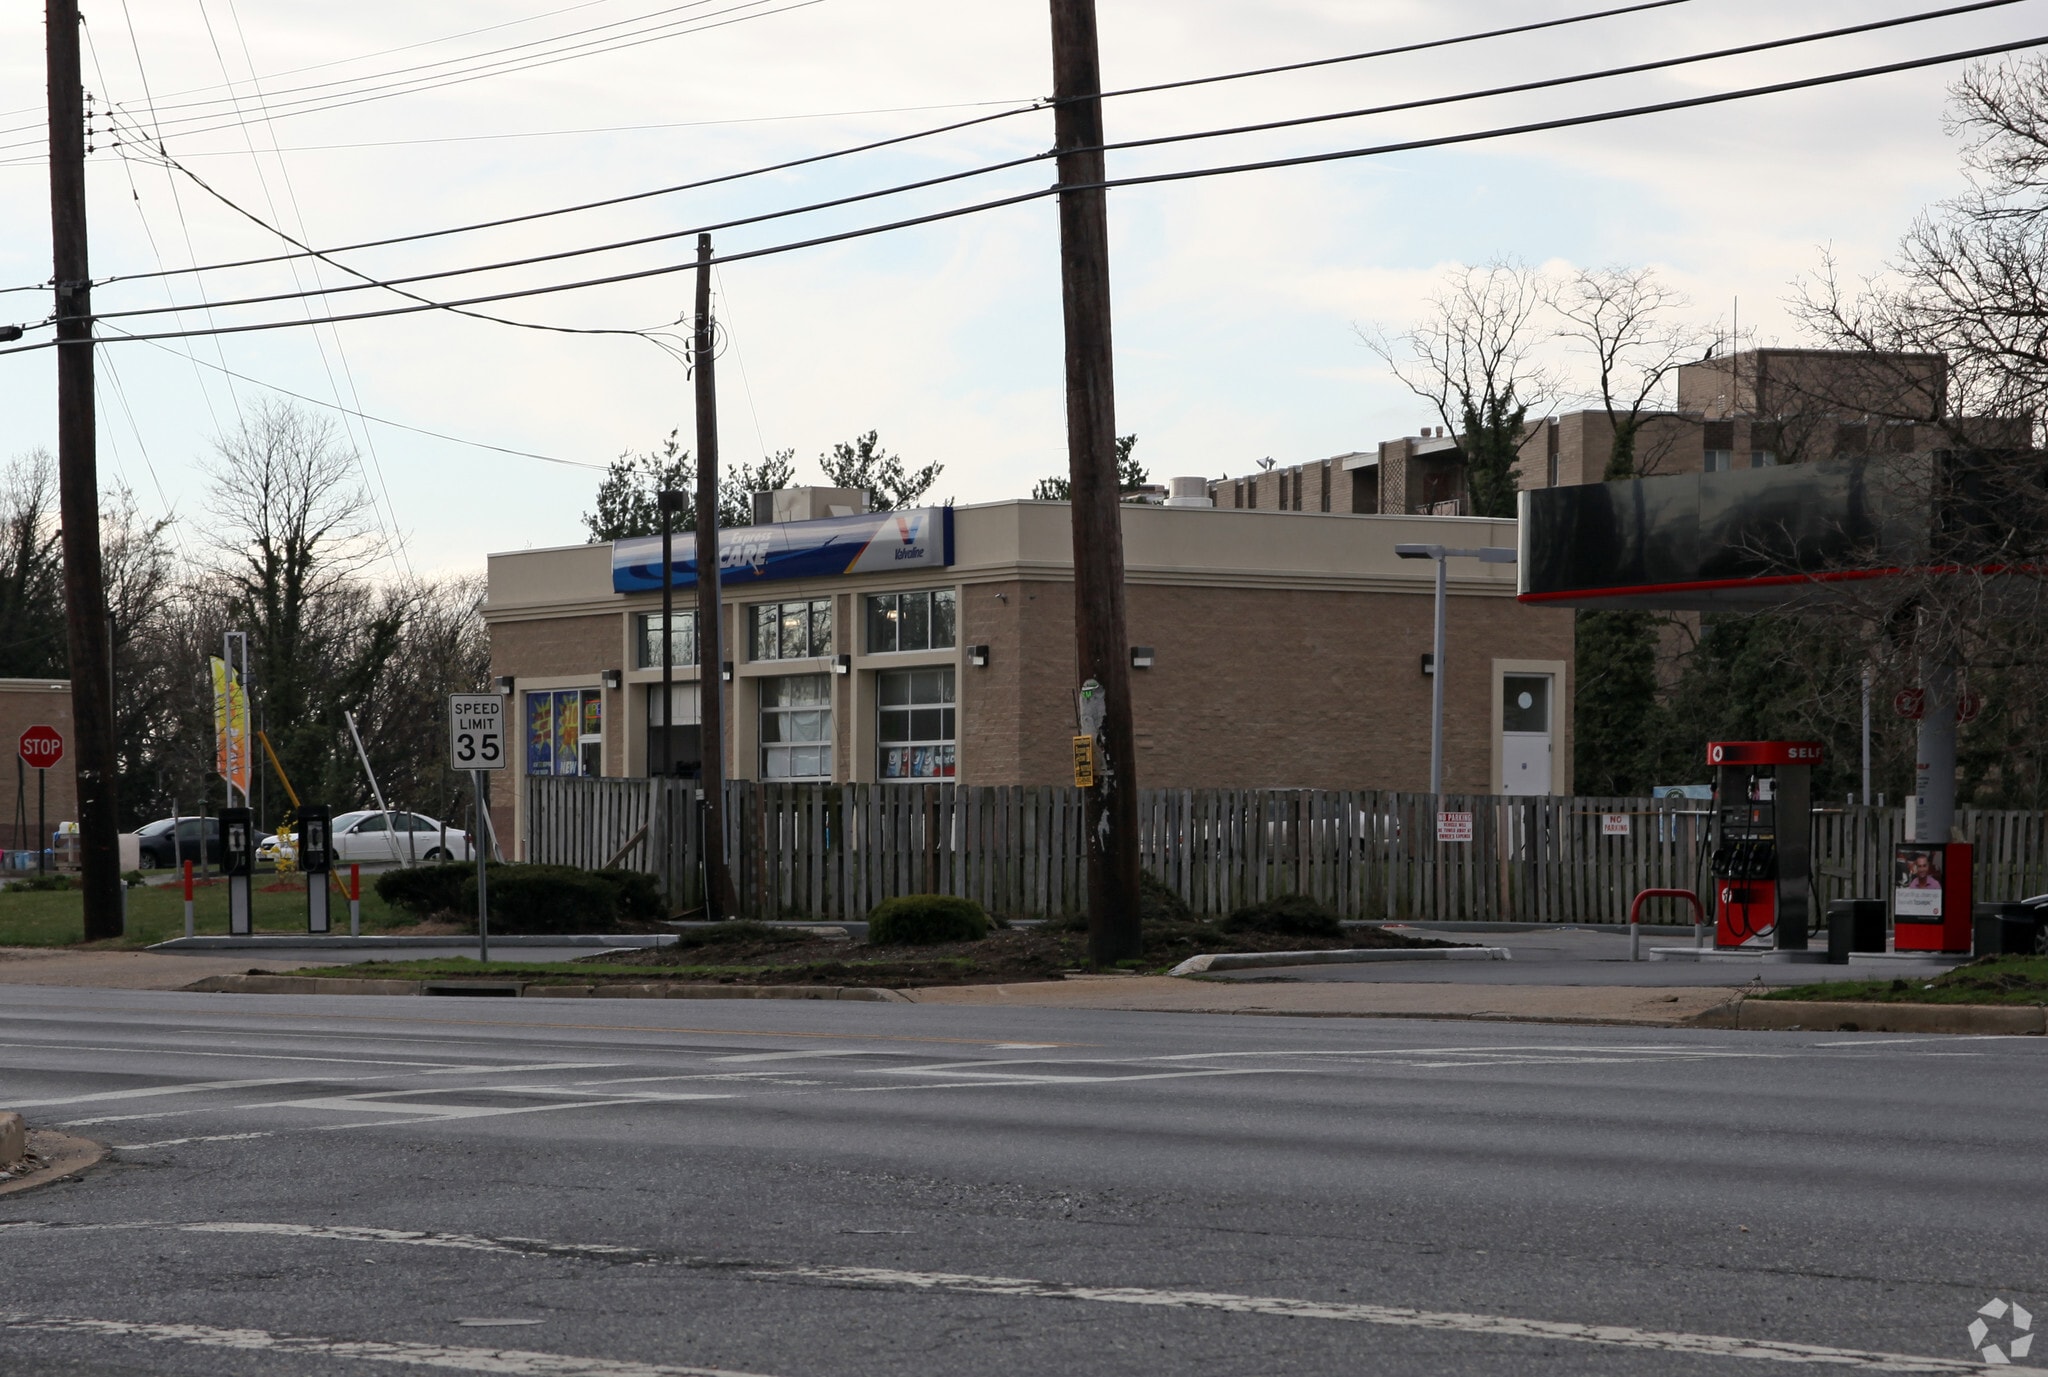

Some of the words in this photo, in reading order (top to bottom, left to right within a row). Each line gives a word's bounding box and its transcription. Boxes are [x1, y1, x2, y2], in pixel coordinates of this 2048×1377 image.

[730, 531, 773, 546] Express
[894, 546, 924, 561] Valvoline
[455, 703, 499, 715] SPEED
[460, 718, 494, 730] LIMIT
[23, 738, 61, 755] STOP
[457, 734, 500, 761] 35
[1788, 747, 1820, 758] SELF
[1610, 815, 1622, 824] NO
[1604, 824, 1628, 832] PARKING
